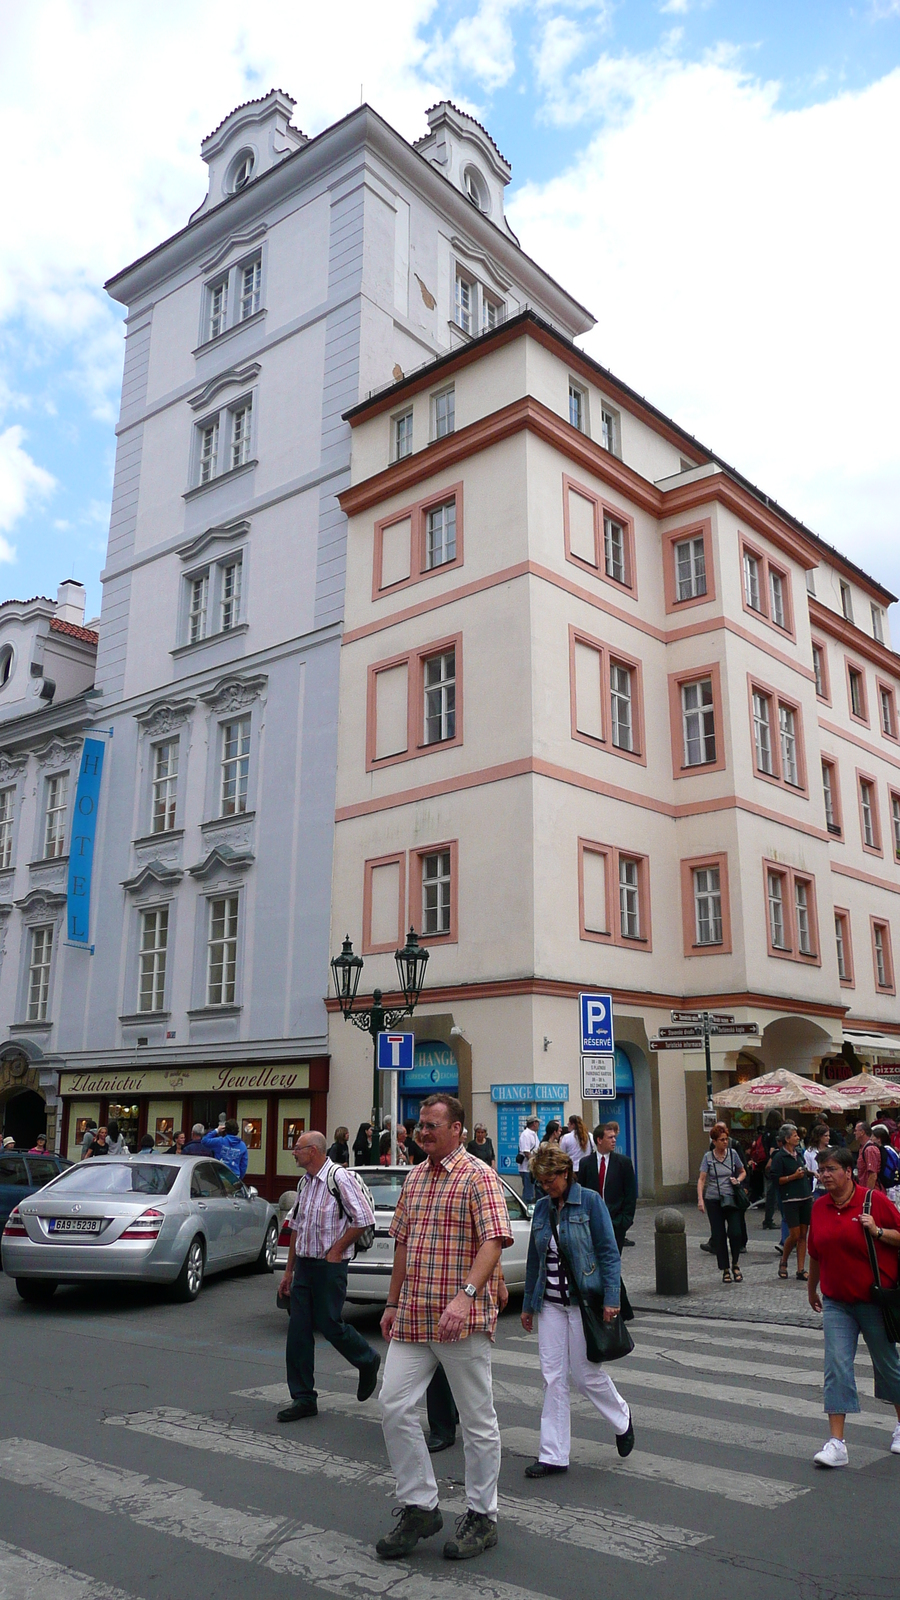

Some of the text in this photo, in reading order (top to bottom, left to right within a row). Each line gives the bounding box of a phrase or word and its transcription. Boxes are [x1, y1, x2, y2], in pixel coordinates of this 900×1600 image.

[71, 754, 100, 937] HOTEL
[587, 1001, 606, 1034] P
[583, 1037, 612, 1046] RÉSERVÉ
[67, 1073, 146, 1092] Zlatnictví
[212, 1067, 298, 1090] Jewellery
[491, 1085, 568, 1100] CHANGE CHANGE
[76, 1220, 97, 1230] 5238
